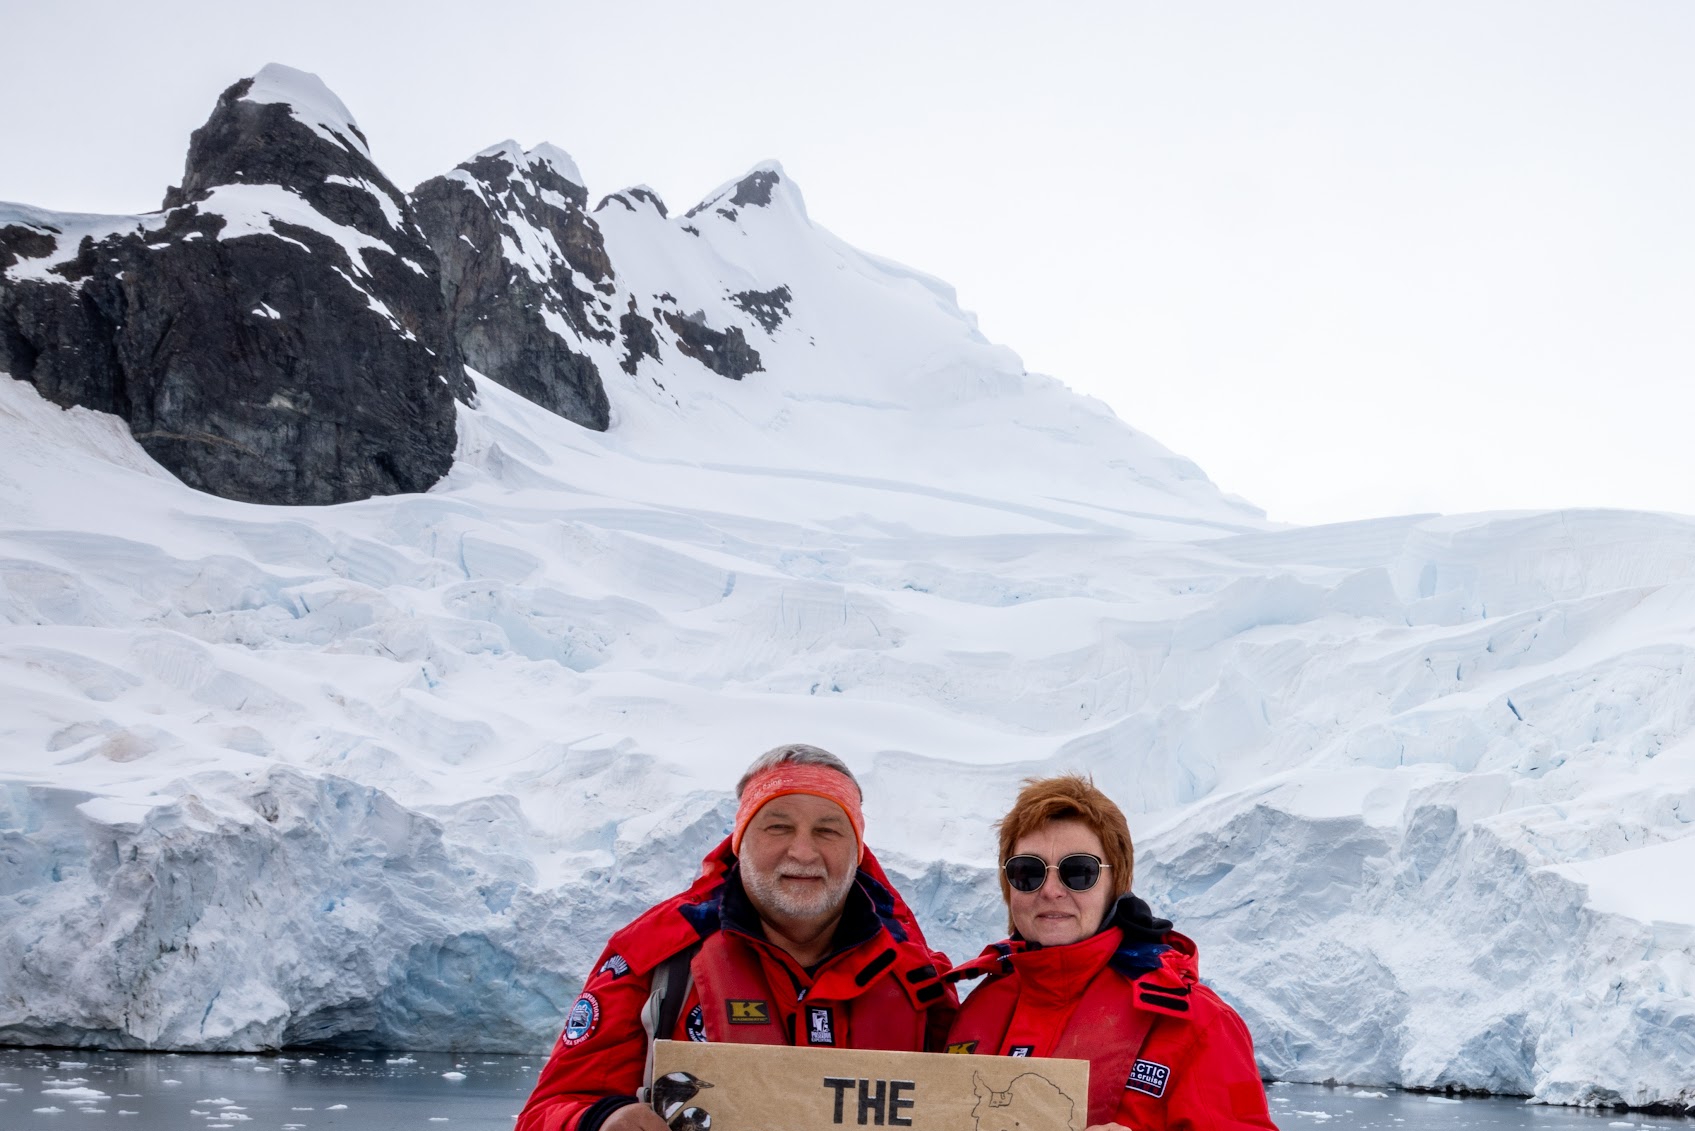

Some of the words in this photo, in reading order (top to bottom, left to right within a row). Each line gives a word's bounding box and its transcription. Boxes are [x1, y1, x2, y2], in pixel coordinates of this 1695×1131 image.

[730, 1001, 766, 1017] K
[1137, 1073, 1163, 1085] cruise
[823, 1076, 916, 1126] THE
